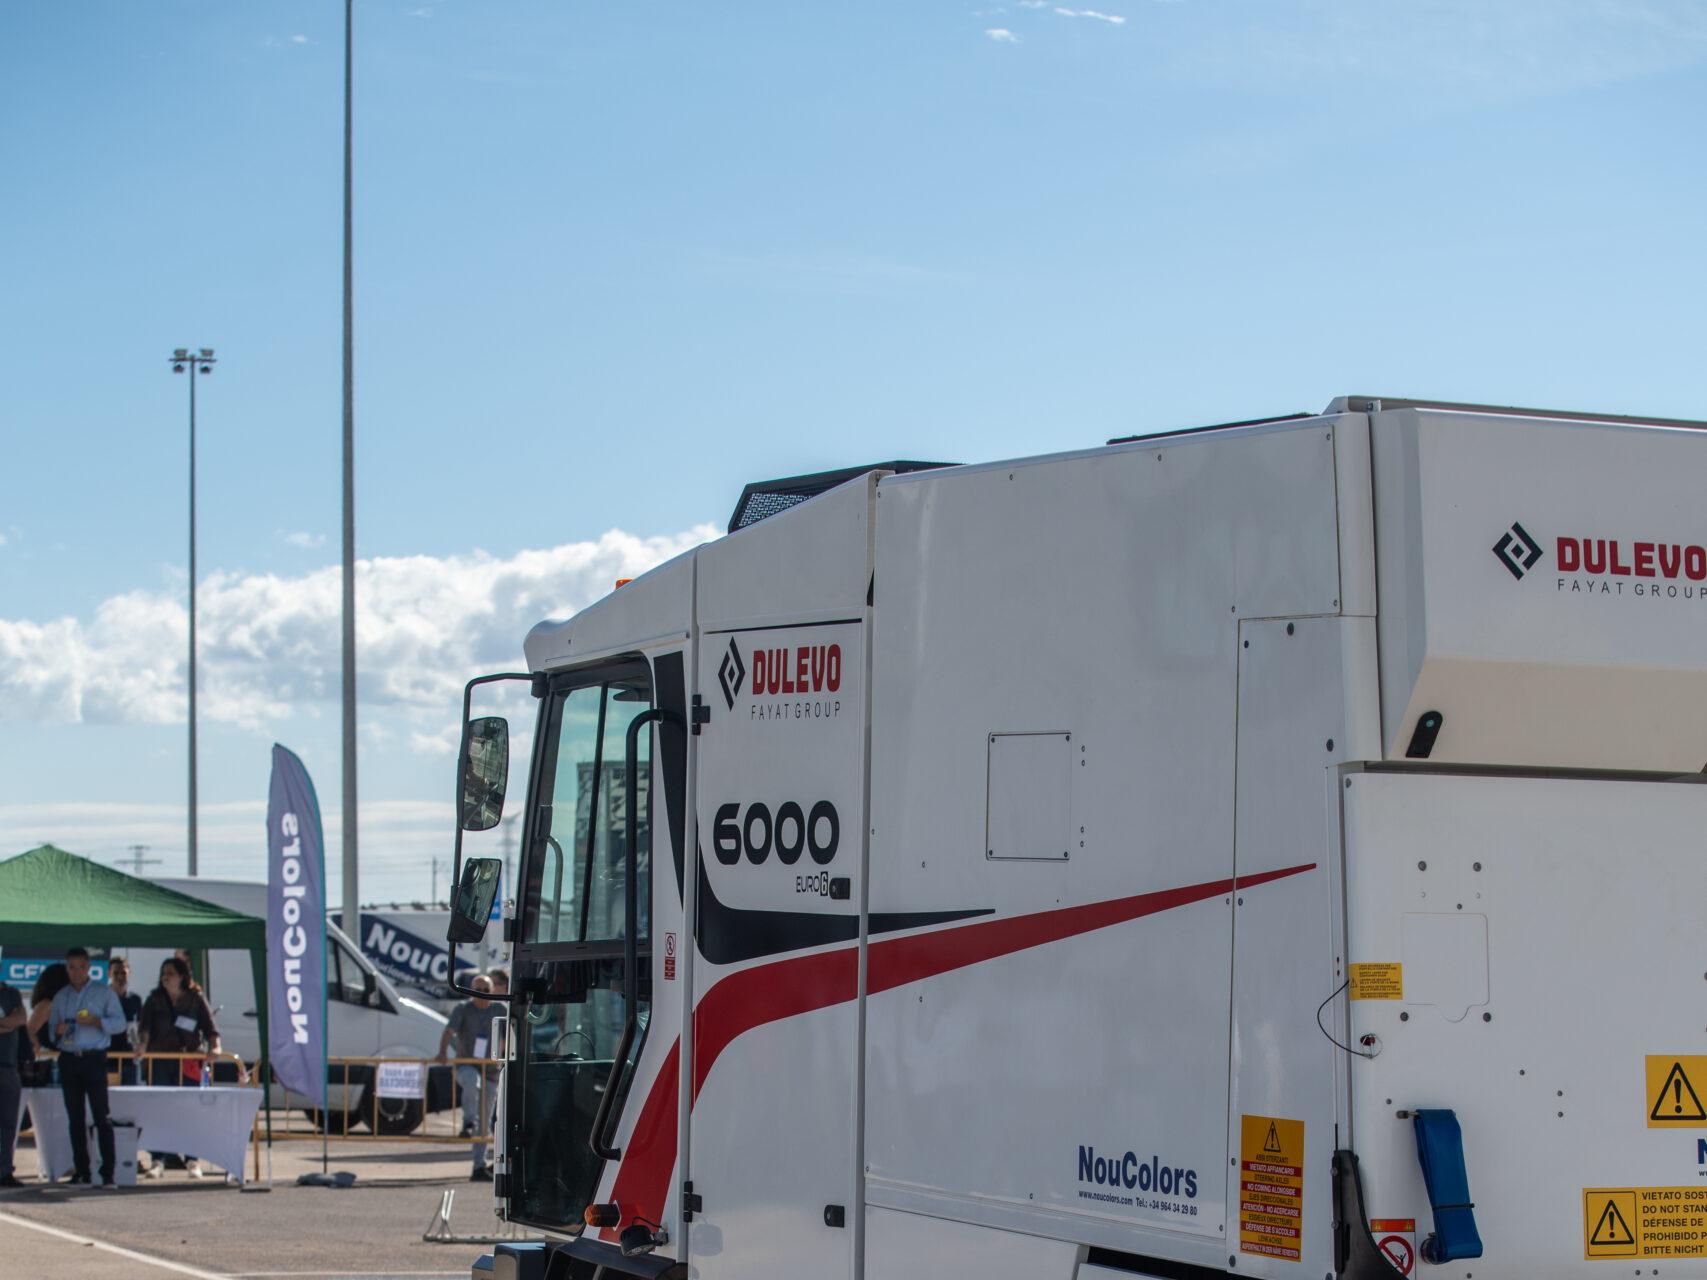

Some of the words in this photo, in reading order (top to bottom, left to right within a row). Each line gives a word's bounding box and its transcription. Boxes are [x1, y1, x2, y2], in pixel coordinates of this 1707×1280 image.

[1557, 536, 1707, 581] DULEVO
[1557, 578, 1624, 595] FAYAT
[1634, 583, 1707, 600] GROUP
[752, 644, 841, 696] DULEVO
[751, 703, 790, 720] FAYAT
[795, 701, 841, 719] GROUP
[713, 800, 840, 865] 6000
[1079, 1145, 1198, 1199] NouColors
[1078, 1190, 1134, 1205] www.noucolors.com
[1160, 1201, 1171, 1212] 964
[1172, 1203, 1181, 1213] 34
[1181, 1204, 1189, 1215] 29
[1189, 1205, 1198, 1216] 80
[1641, 1191, 1682, 1200] VIETATO
[1642, 1205, 1657, 1214] DO
[1660, 1205, 1680, 1213] NOT
[1643, 1217, 1688, 1227] DÉFENSE
[1690, 1218, 1704, 1226] DE
[1643, 1232, 1698, 1240] PROHIBIDO
[1644, 1246, 1671, 1254] BITTE
[1674, 1245, 1704, 1254] NICHT
